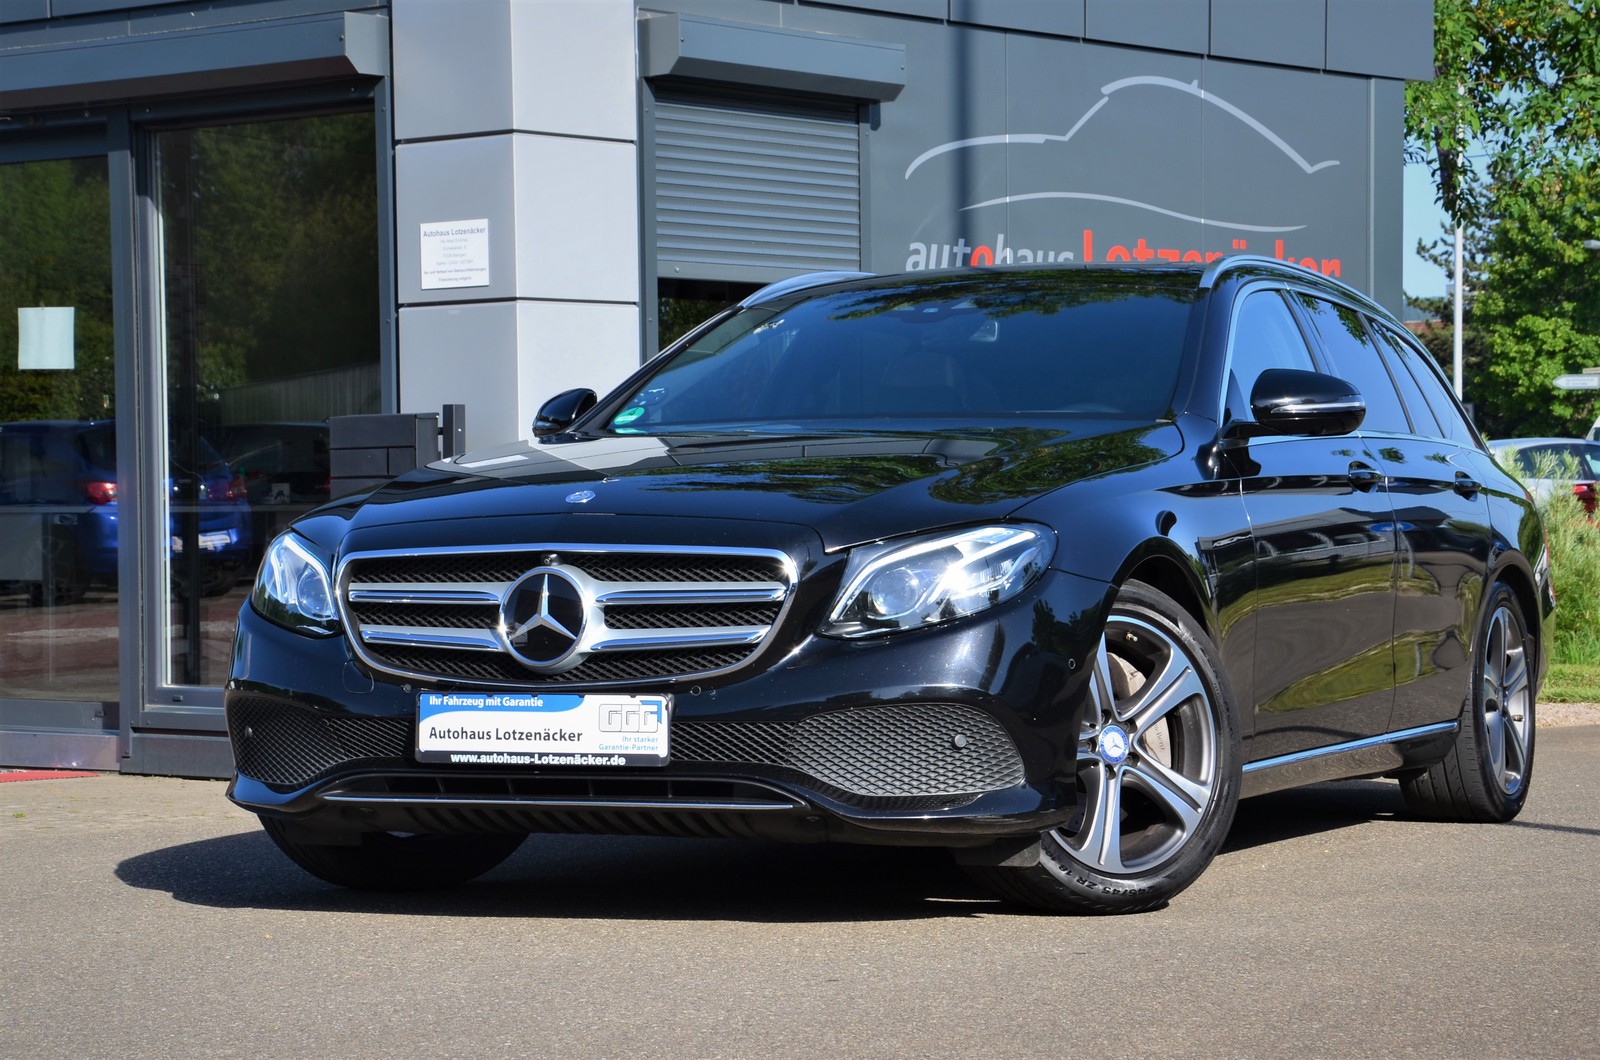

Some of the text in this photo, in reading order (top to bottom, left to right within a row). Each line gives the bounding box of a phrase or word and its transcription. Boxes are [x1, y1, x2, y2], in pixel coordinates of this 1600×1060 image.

[423, 229, 450, 238] Autohaus
[429, 695, 544, 708] Ihr Fahrzeug mit Garantie
[429, 726, 583, 742] Autohaus Lotzenäcker
[598, 743, 659, 751] Garantie-Partner
[450, 753, 627, 767] www.autohaus-Lotzenäcker.de
[1076, 876, 1098, 890] ZR
